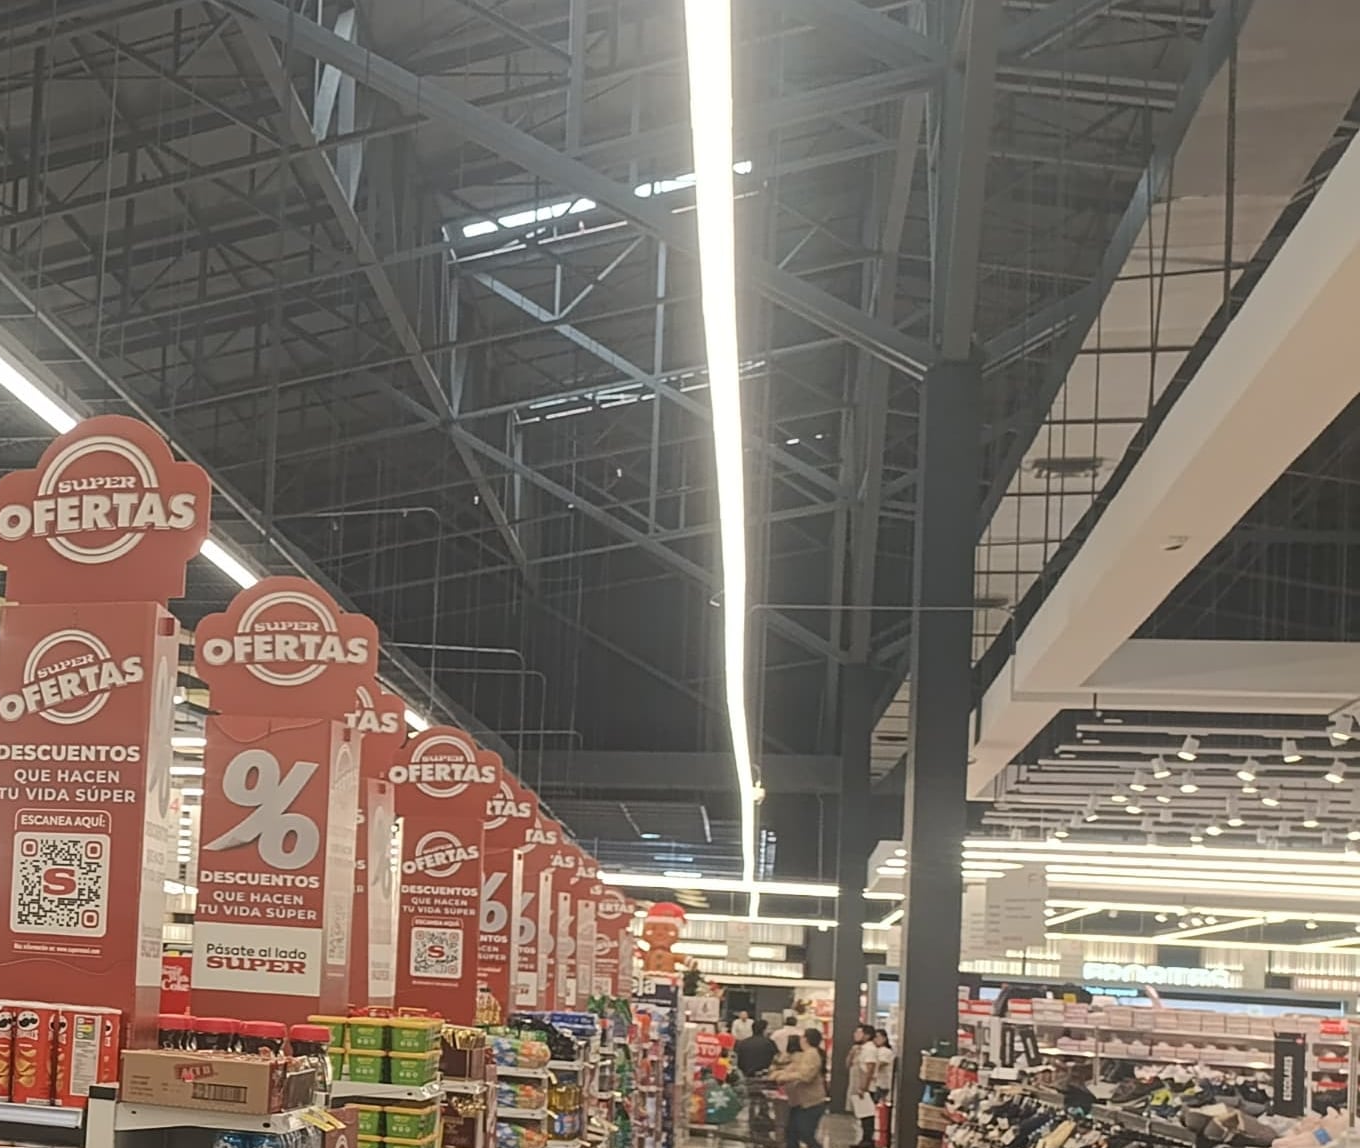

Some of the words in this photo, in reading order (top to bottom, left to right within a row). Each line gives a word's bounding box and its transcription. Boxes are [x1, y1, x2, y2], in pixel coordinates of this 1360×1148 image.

[57, 475, 137, 493] SUPER
[253, 621, 321, 634] SUPER
[202, 633, 369, 666] OFERTAS
[36, 653, 95, 679] SUPER
[14, 769, 51, 784] QUE
[56, 769, 120, 784] HACEN
[388, 763, 496, 784] OFERTAS
[25, 787, 68, 802] VIDA
[74, 783, 137, 803] SÚPER
[20, 813, 73, 827] ESCANEA
[402, 845, 480, 874] OFERTAS
[42, 867, 77, 896] S
[200, 870, 320, 890] DESCUENTOS
[213, 890, 245, 905] QUE
[249, 891, 304, 906] HACEN
[400, 885, 479, 897] DESCUENTOS
[198, 903, 219, 916] TU
[222, 904, 260, 918] VIDA
[402, 905, 415, 914] TU
[417, 906, 440, 915] VIDA
[411, 897, 431, 906] QUE
[434, 898, 468, 907] HACEN
[206, 942, 256, 959] Pásate
[258, 944, 271, 959] al
[273, 945, 307, 961] lado
[205, 956, 307, 976] SUPER
